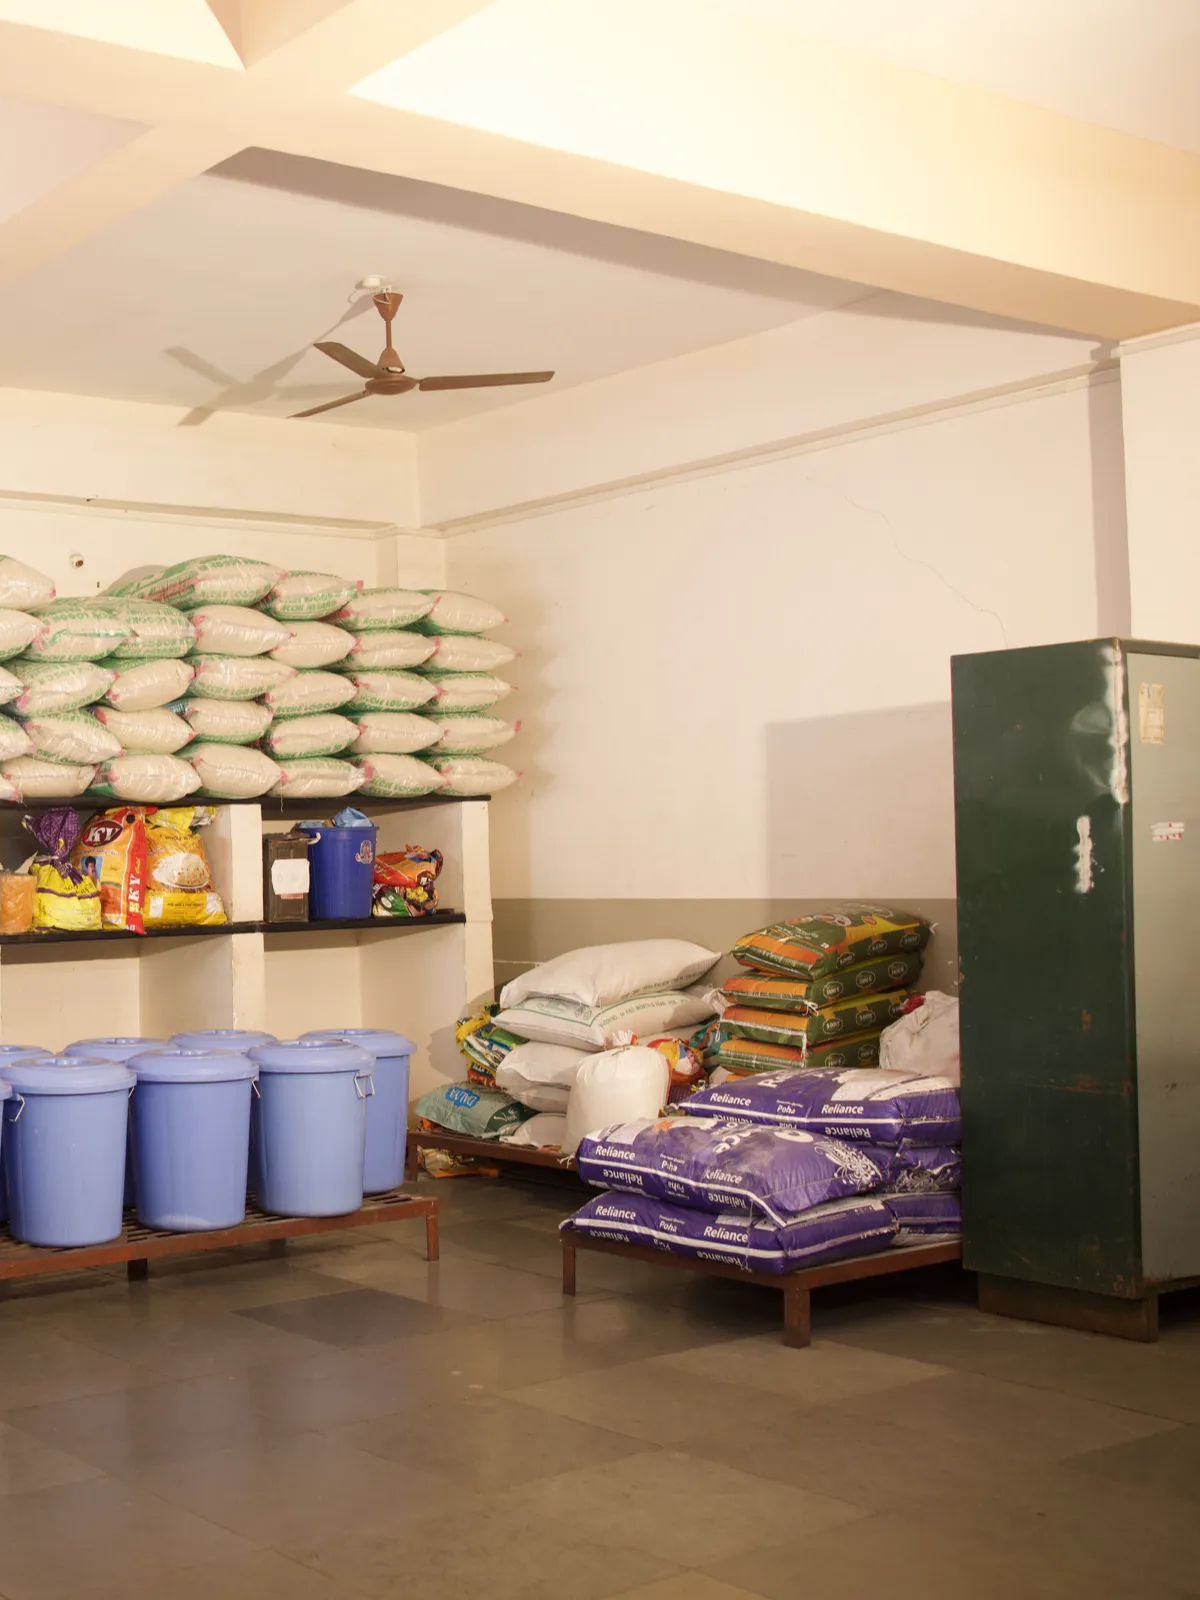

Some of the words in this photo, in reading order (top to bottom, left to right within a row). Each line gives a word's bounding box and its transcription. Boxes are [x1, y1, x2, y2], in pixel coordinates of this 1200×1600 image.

[86, 826, 121, 843] KY
[128, 873, 141, 902] KY
[709, 1092, 752, 1107] Reliance
[776, 1104, 796, 1115] Poha
[821, 1104, 864, 1115] Reliance
[825, 1126, 872, 1138] Reliance
[595, 1146, 636, 1161] Reliance
[603, 1168, 643, 1186] Reliance
[703, 1169, 743, 1184] Reliance
[708, 1193, 746, 1208] Reliance
[595, 1205, 637, 1220] Reliance
[659, 1220, 678, 1233] Poha
[703, 1226, 749, 1243] Reliance
